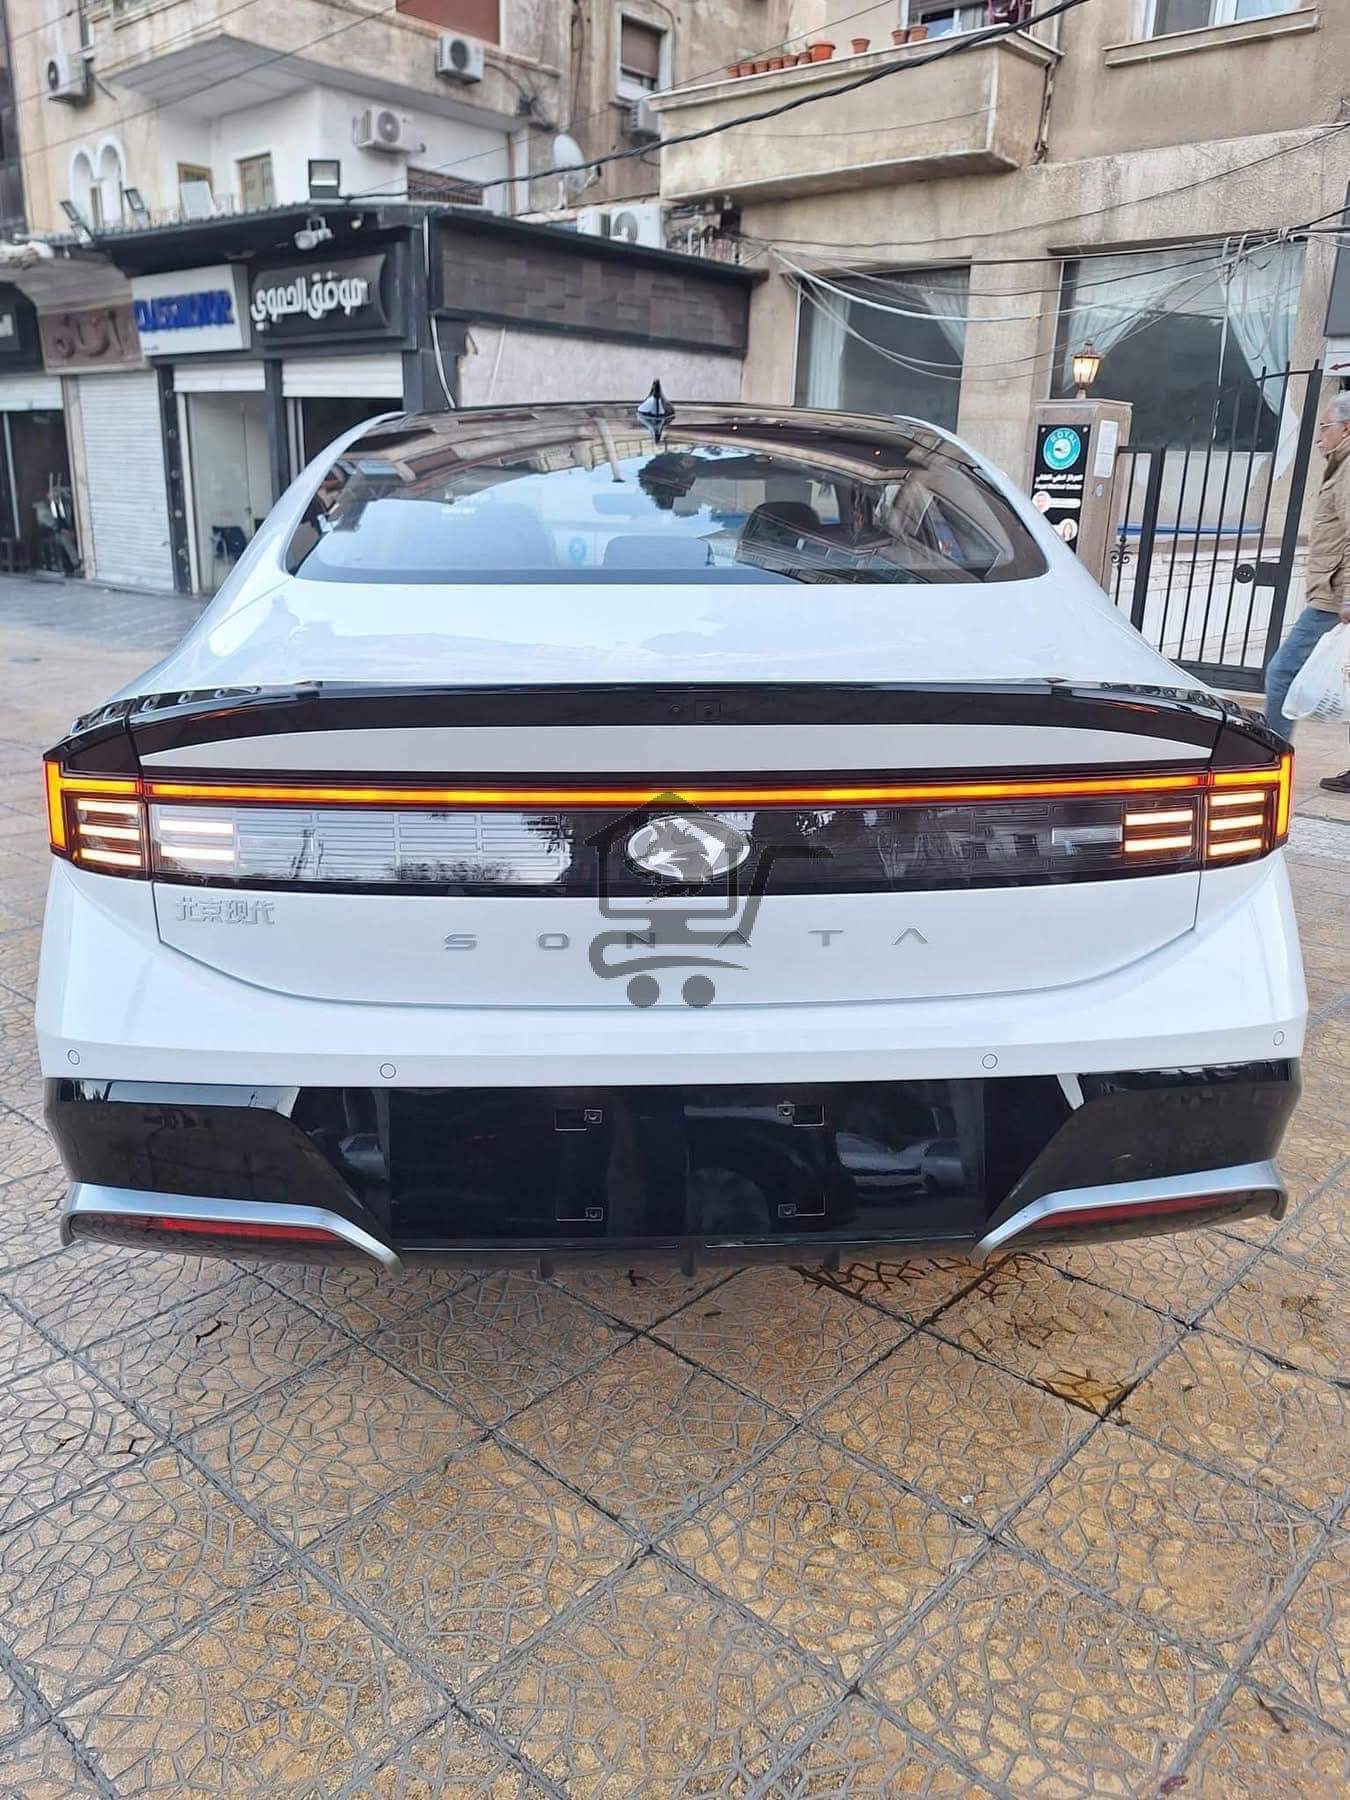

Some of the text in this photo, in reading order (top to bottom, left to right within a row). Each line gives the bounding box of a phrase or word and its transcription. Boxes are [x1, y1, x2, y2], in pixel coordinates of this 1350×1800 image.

[251, 276, 307, 331] الحموي
[307, 270, 368, 320] موفق
[176, 896, 275, 925] 北京现代
[443, 927, 928, 951] SONATA
